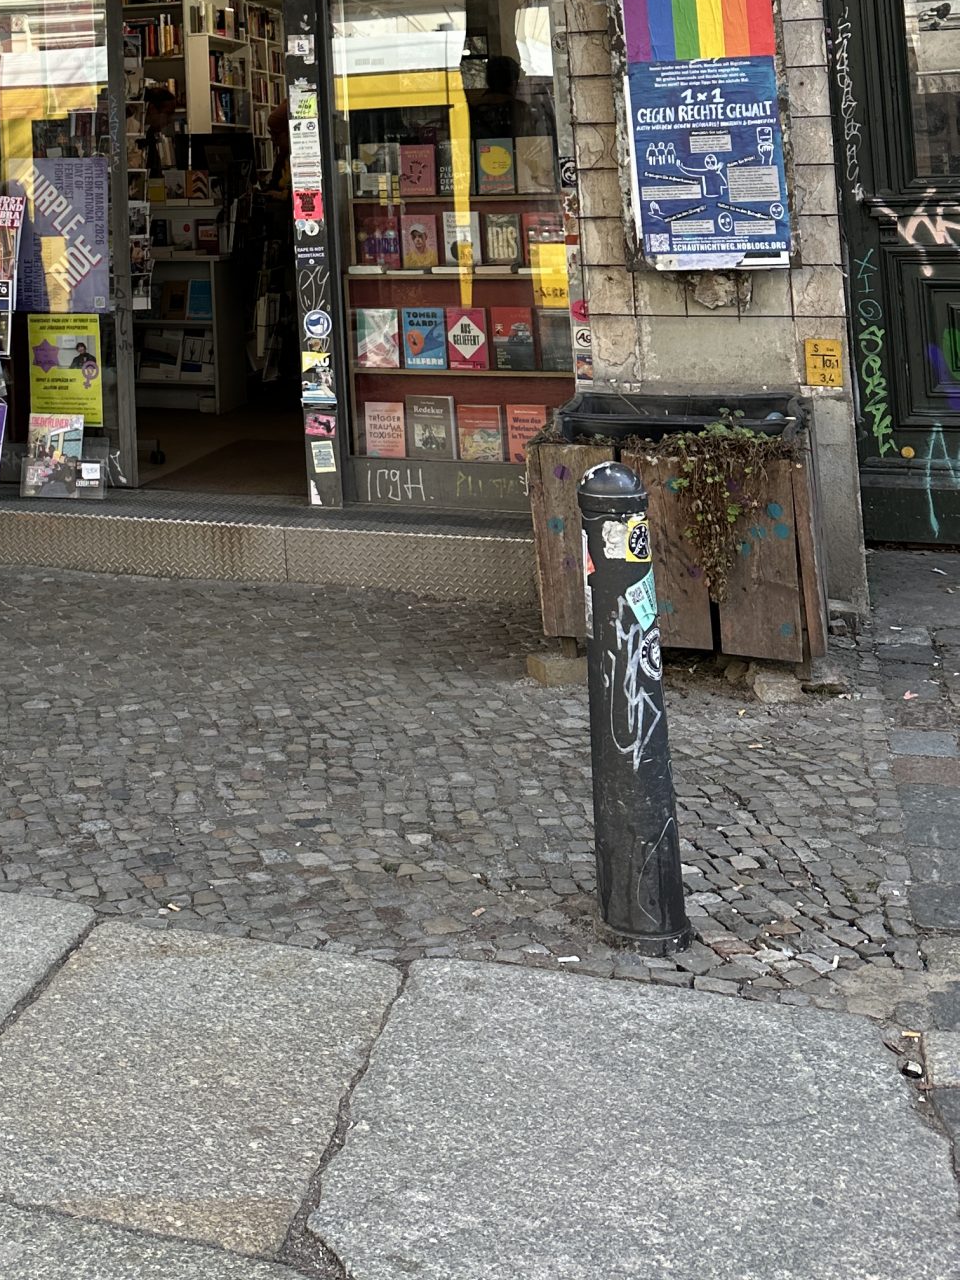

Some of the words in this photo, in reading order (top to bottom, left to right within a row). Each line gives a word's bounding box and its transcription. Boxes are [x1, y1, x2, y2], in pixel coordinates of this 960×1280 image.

[637, 106, 675, 123] GEGEN
[678, 103, 724, 121] RECHTE
[726, 100, 773, 118] GEWALT
[74, 163, 83, 178] DAY
[54, 163, 64, 192] FIGHTS
[64, 163, 73, 200] FEMINIST
[74, 180, 83, 190] OF
[94, 180, 104, 191] OF
[84, 163, 94, 224] INTERNATIONAL
[16, 164, 86, 240] PURPLE
[94, 192, 104, 222] MARCH
[672, 241, 787, 252] SCHAUTNICHTWEG.NOBLOGS.ORG
[48, 234, 102, 293] RIDE
[406, 311, 437, 319] TOMER
[460, 323, 474, 334] AUS-
[452, 334, 480, 346] GELIEFERT
[407, 357, 444, 366] LIEFERN
[820, 374, 835, 383] 3,4
[413, 405, 444, 414] Redekur
[368, 414, 401, 422] TRIGGER
[369, 431, 402, 439] TOXISCH
